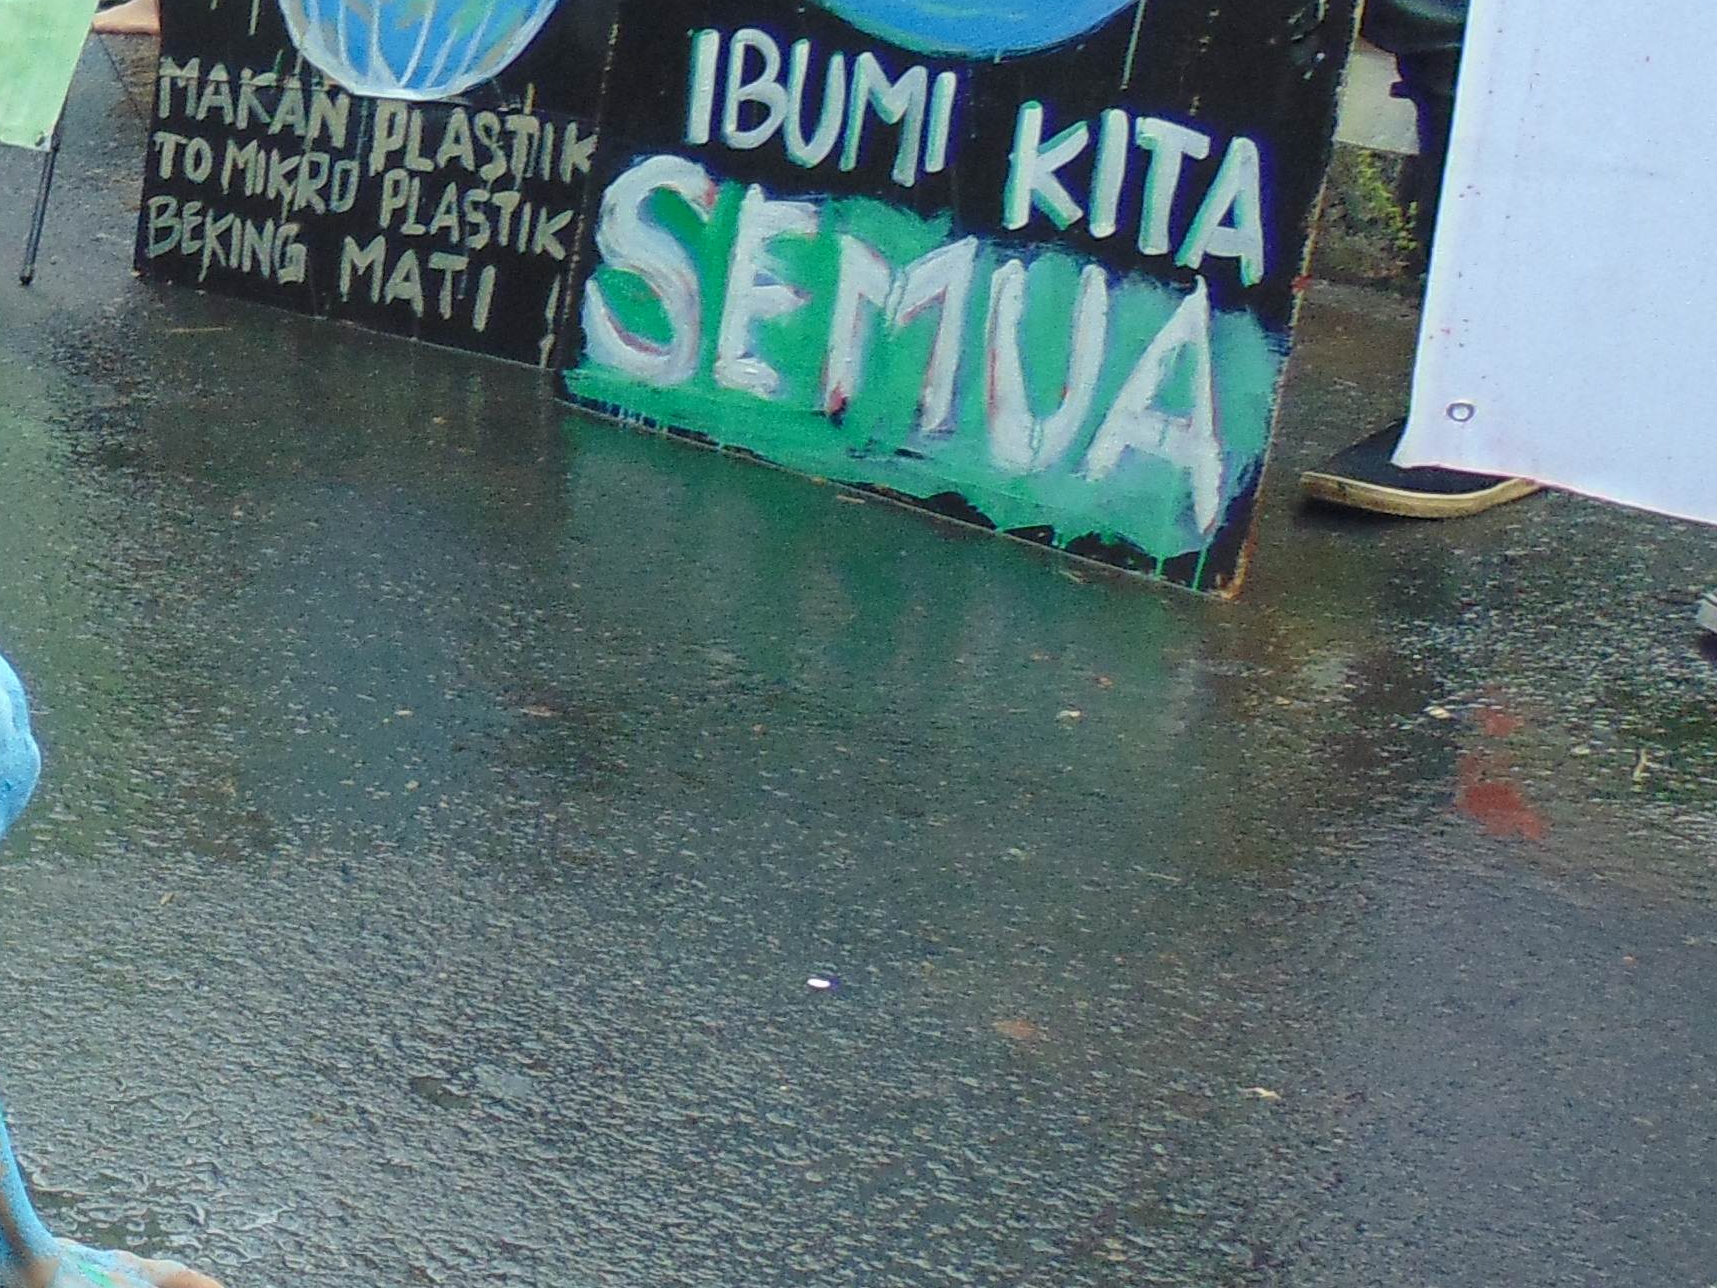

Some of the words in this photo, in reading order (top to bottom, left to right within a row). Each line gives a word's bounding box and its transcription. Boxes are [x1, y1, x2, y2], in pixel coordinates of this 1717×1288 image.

[159, 57, 351, 149] MAKAN
[368, 98, 597, 184] PLASTIK
[686, 27, 958, 186] IBUMI
[1003, 99, 1266, 287] KITA
[148, 195, 308, 284] BEKING
[340, 235, 496, 333] MATI
[154, 130, 212, 184] TO
[221, 139, 360, 214] MIKRO
[380, 169, 573, 262] PLASTIK
[581, 153, 1224, 536] SEMUA
